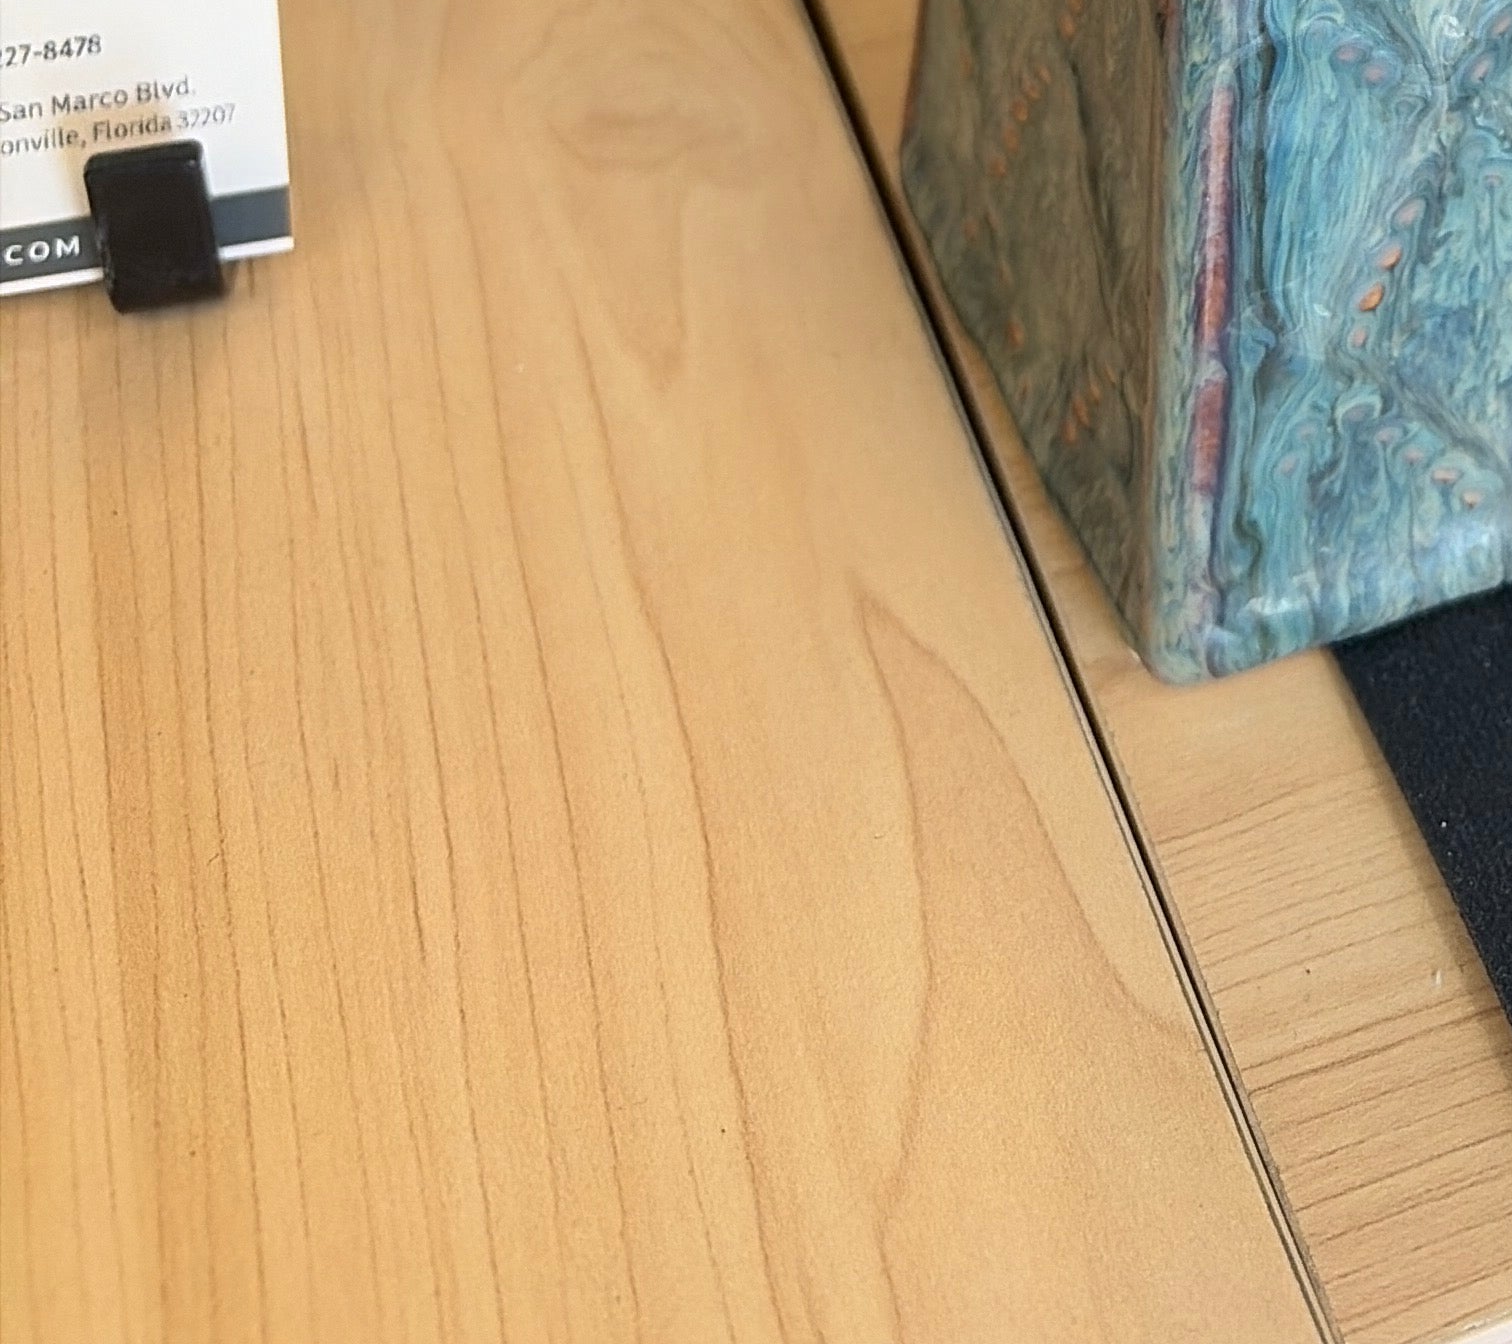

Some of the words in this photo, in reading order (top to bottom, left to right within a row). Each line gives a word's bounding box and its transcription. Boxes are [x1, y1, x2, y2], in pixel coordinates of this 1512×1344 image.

[0, 34, 102, 68] 27-8478
[0, 101, 43, 122] San
[52, 88, 129, 116] Marco
[137, 74, 196, 105] Blvd.
[93, 112, 172, 142] Florida
[4, 235, 80, 266] COM
